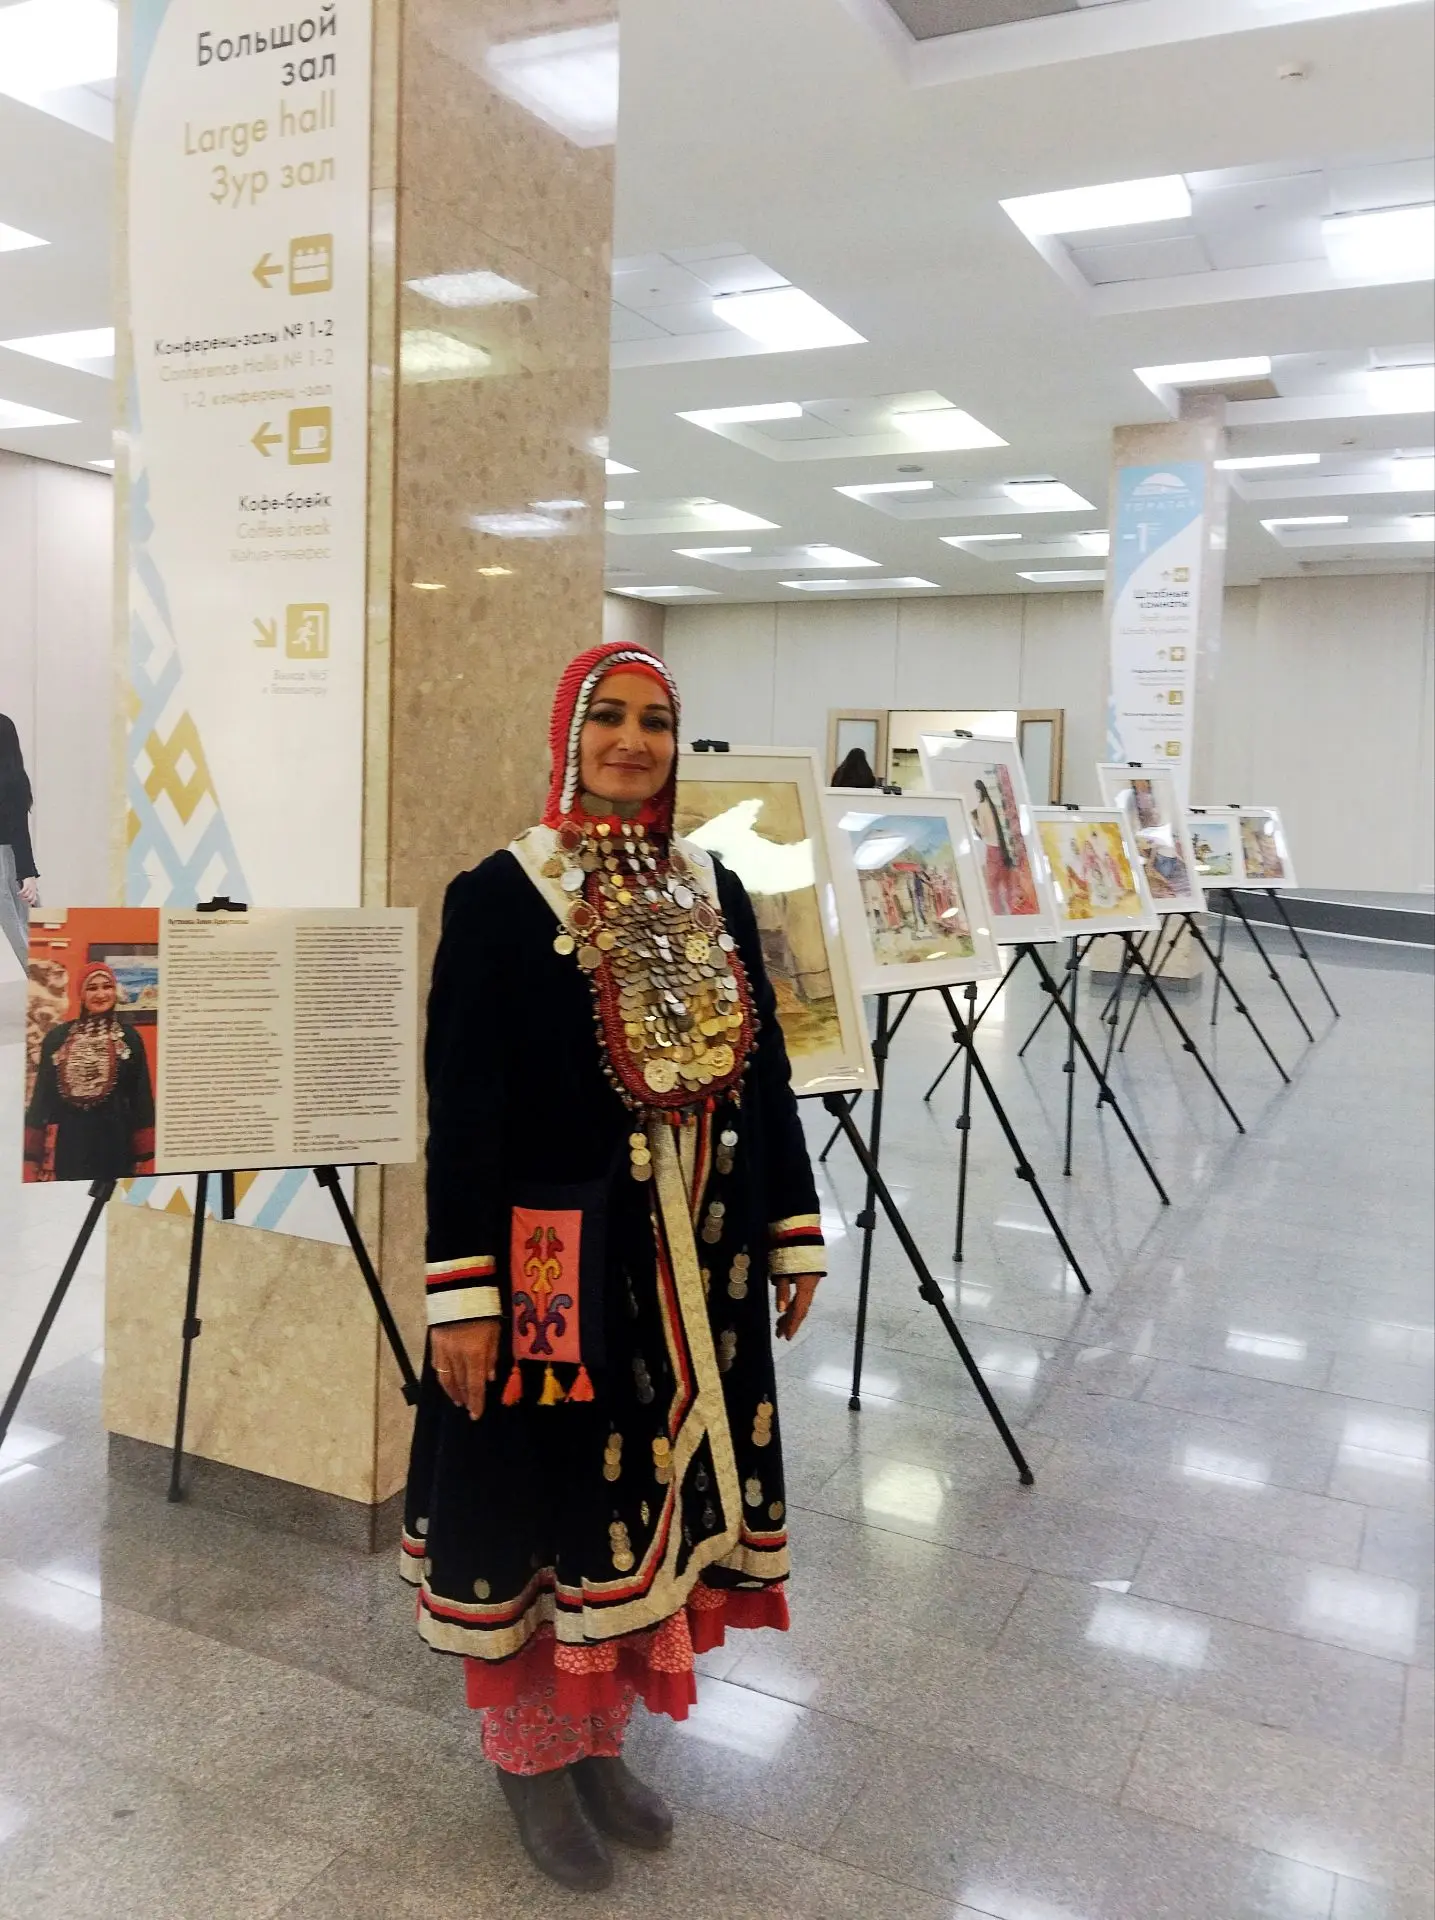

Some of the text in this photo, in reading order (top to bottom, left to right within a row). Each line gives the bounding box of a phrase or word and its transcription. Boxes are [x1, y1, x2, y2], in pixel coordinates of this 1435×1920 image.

[197, 3, 336, 67] Большой
[281, 53, 336, 86] зал
[183, 88, 336, 157] Large hall
[281, 157, 335, 189] зал
[308, 318, 335, 338] 1-2
[308, 347, 335, 367] 1-2
[238, 491, 333, 516] Кофе-брейк
